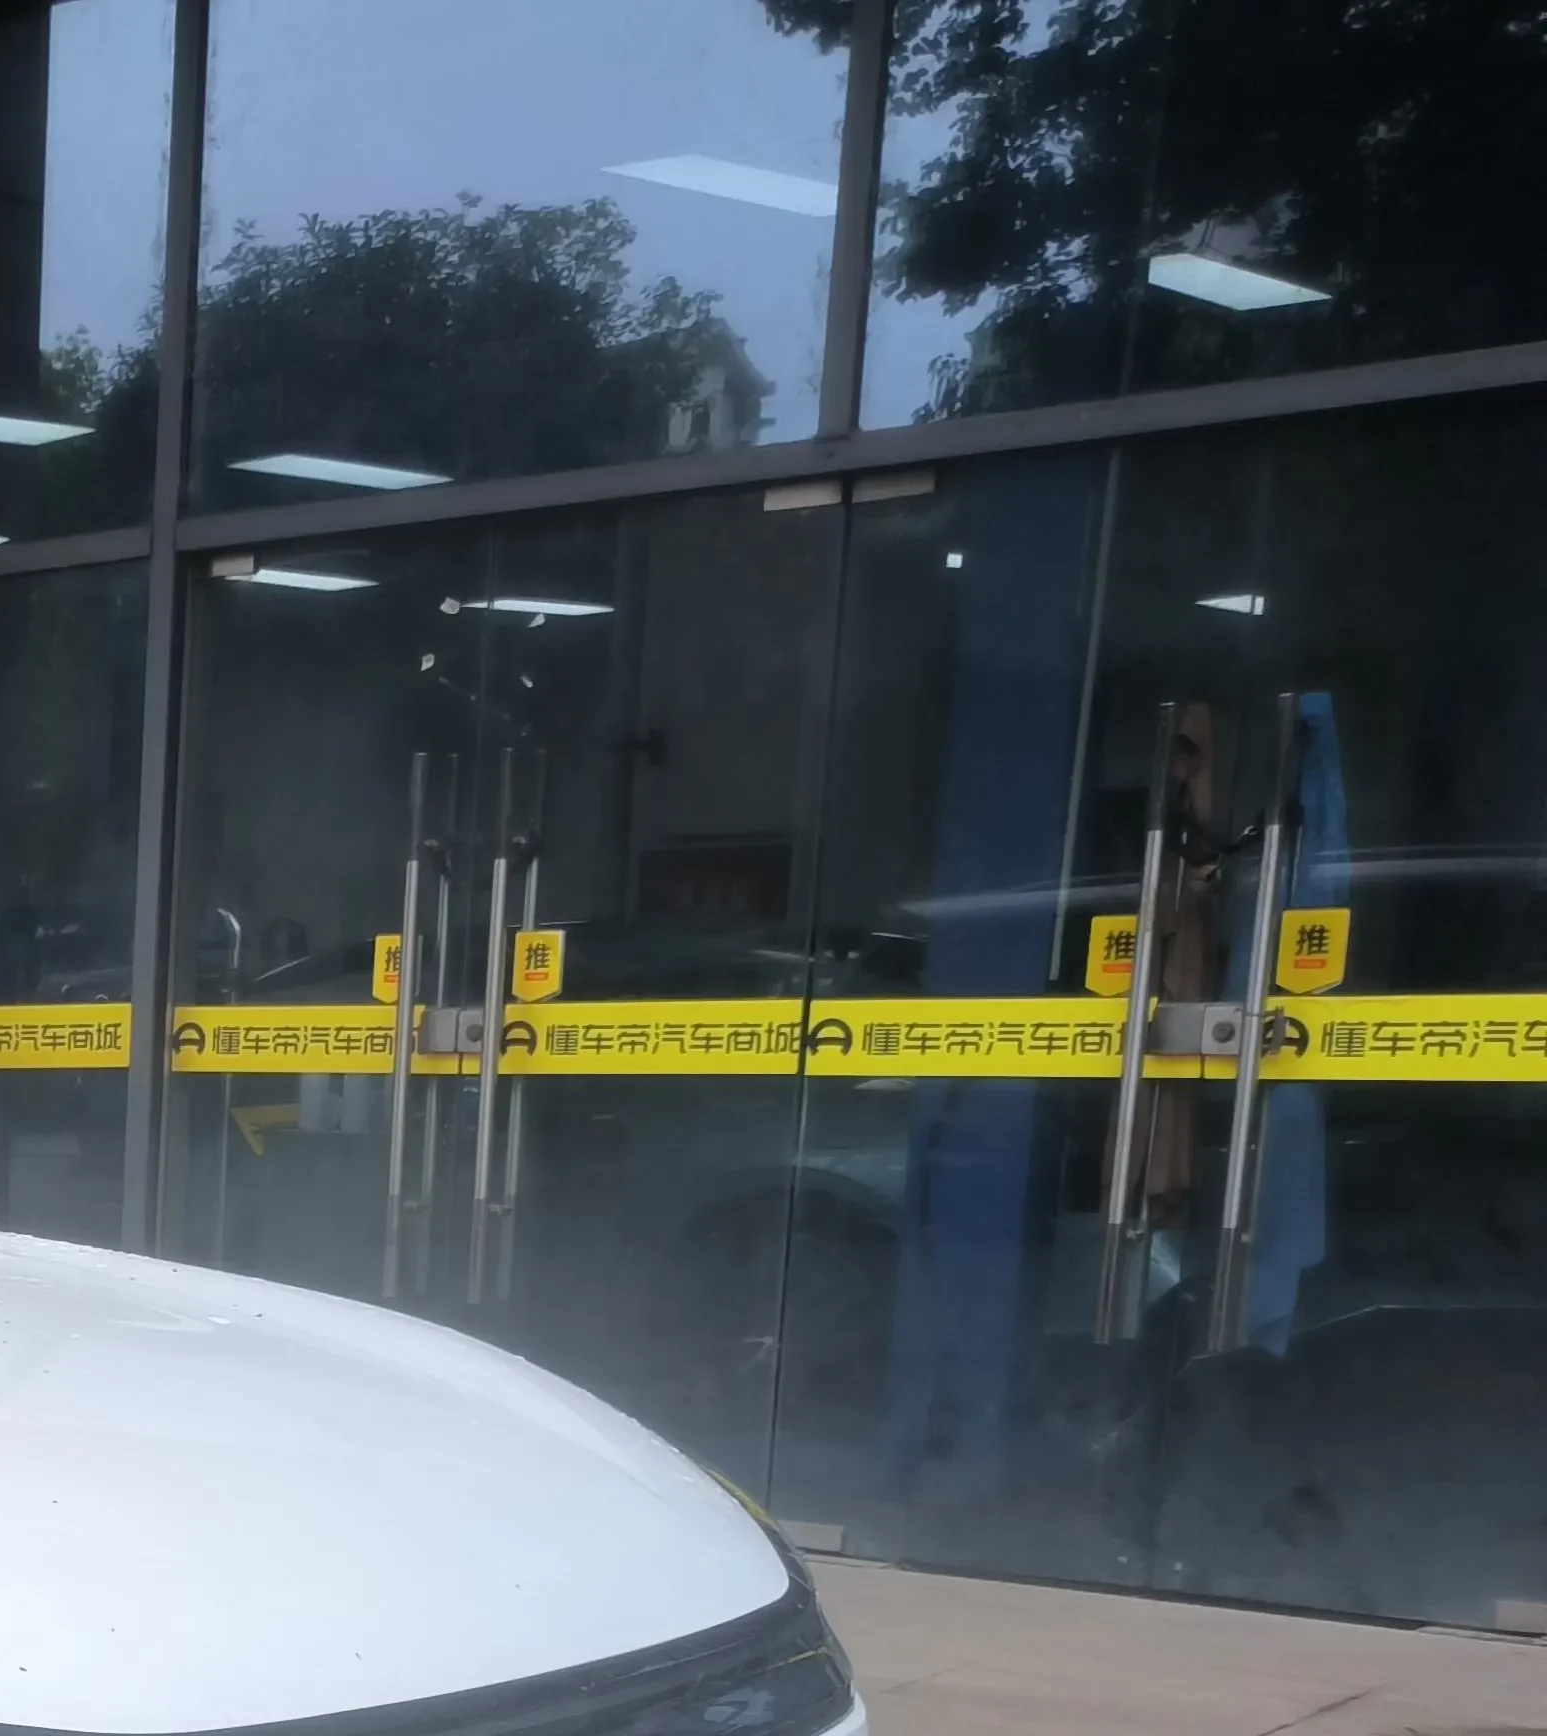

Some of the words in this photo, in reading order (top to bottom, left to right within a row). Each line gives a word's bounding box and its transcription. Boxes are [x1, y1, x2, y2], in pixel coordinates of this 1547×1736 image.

[1103, 930, 1136, 961] 推
[1295, 924, 1332, 956] 推
[524, 943, 551, 971] 推
[212, 1025, 413, 1056] 懂车帝汽车商
[545, 1021, 803, 1056] 懂车帝汽车商城
[861, 1021, 1127, 1057] 懂车帝汽车商
